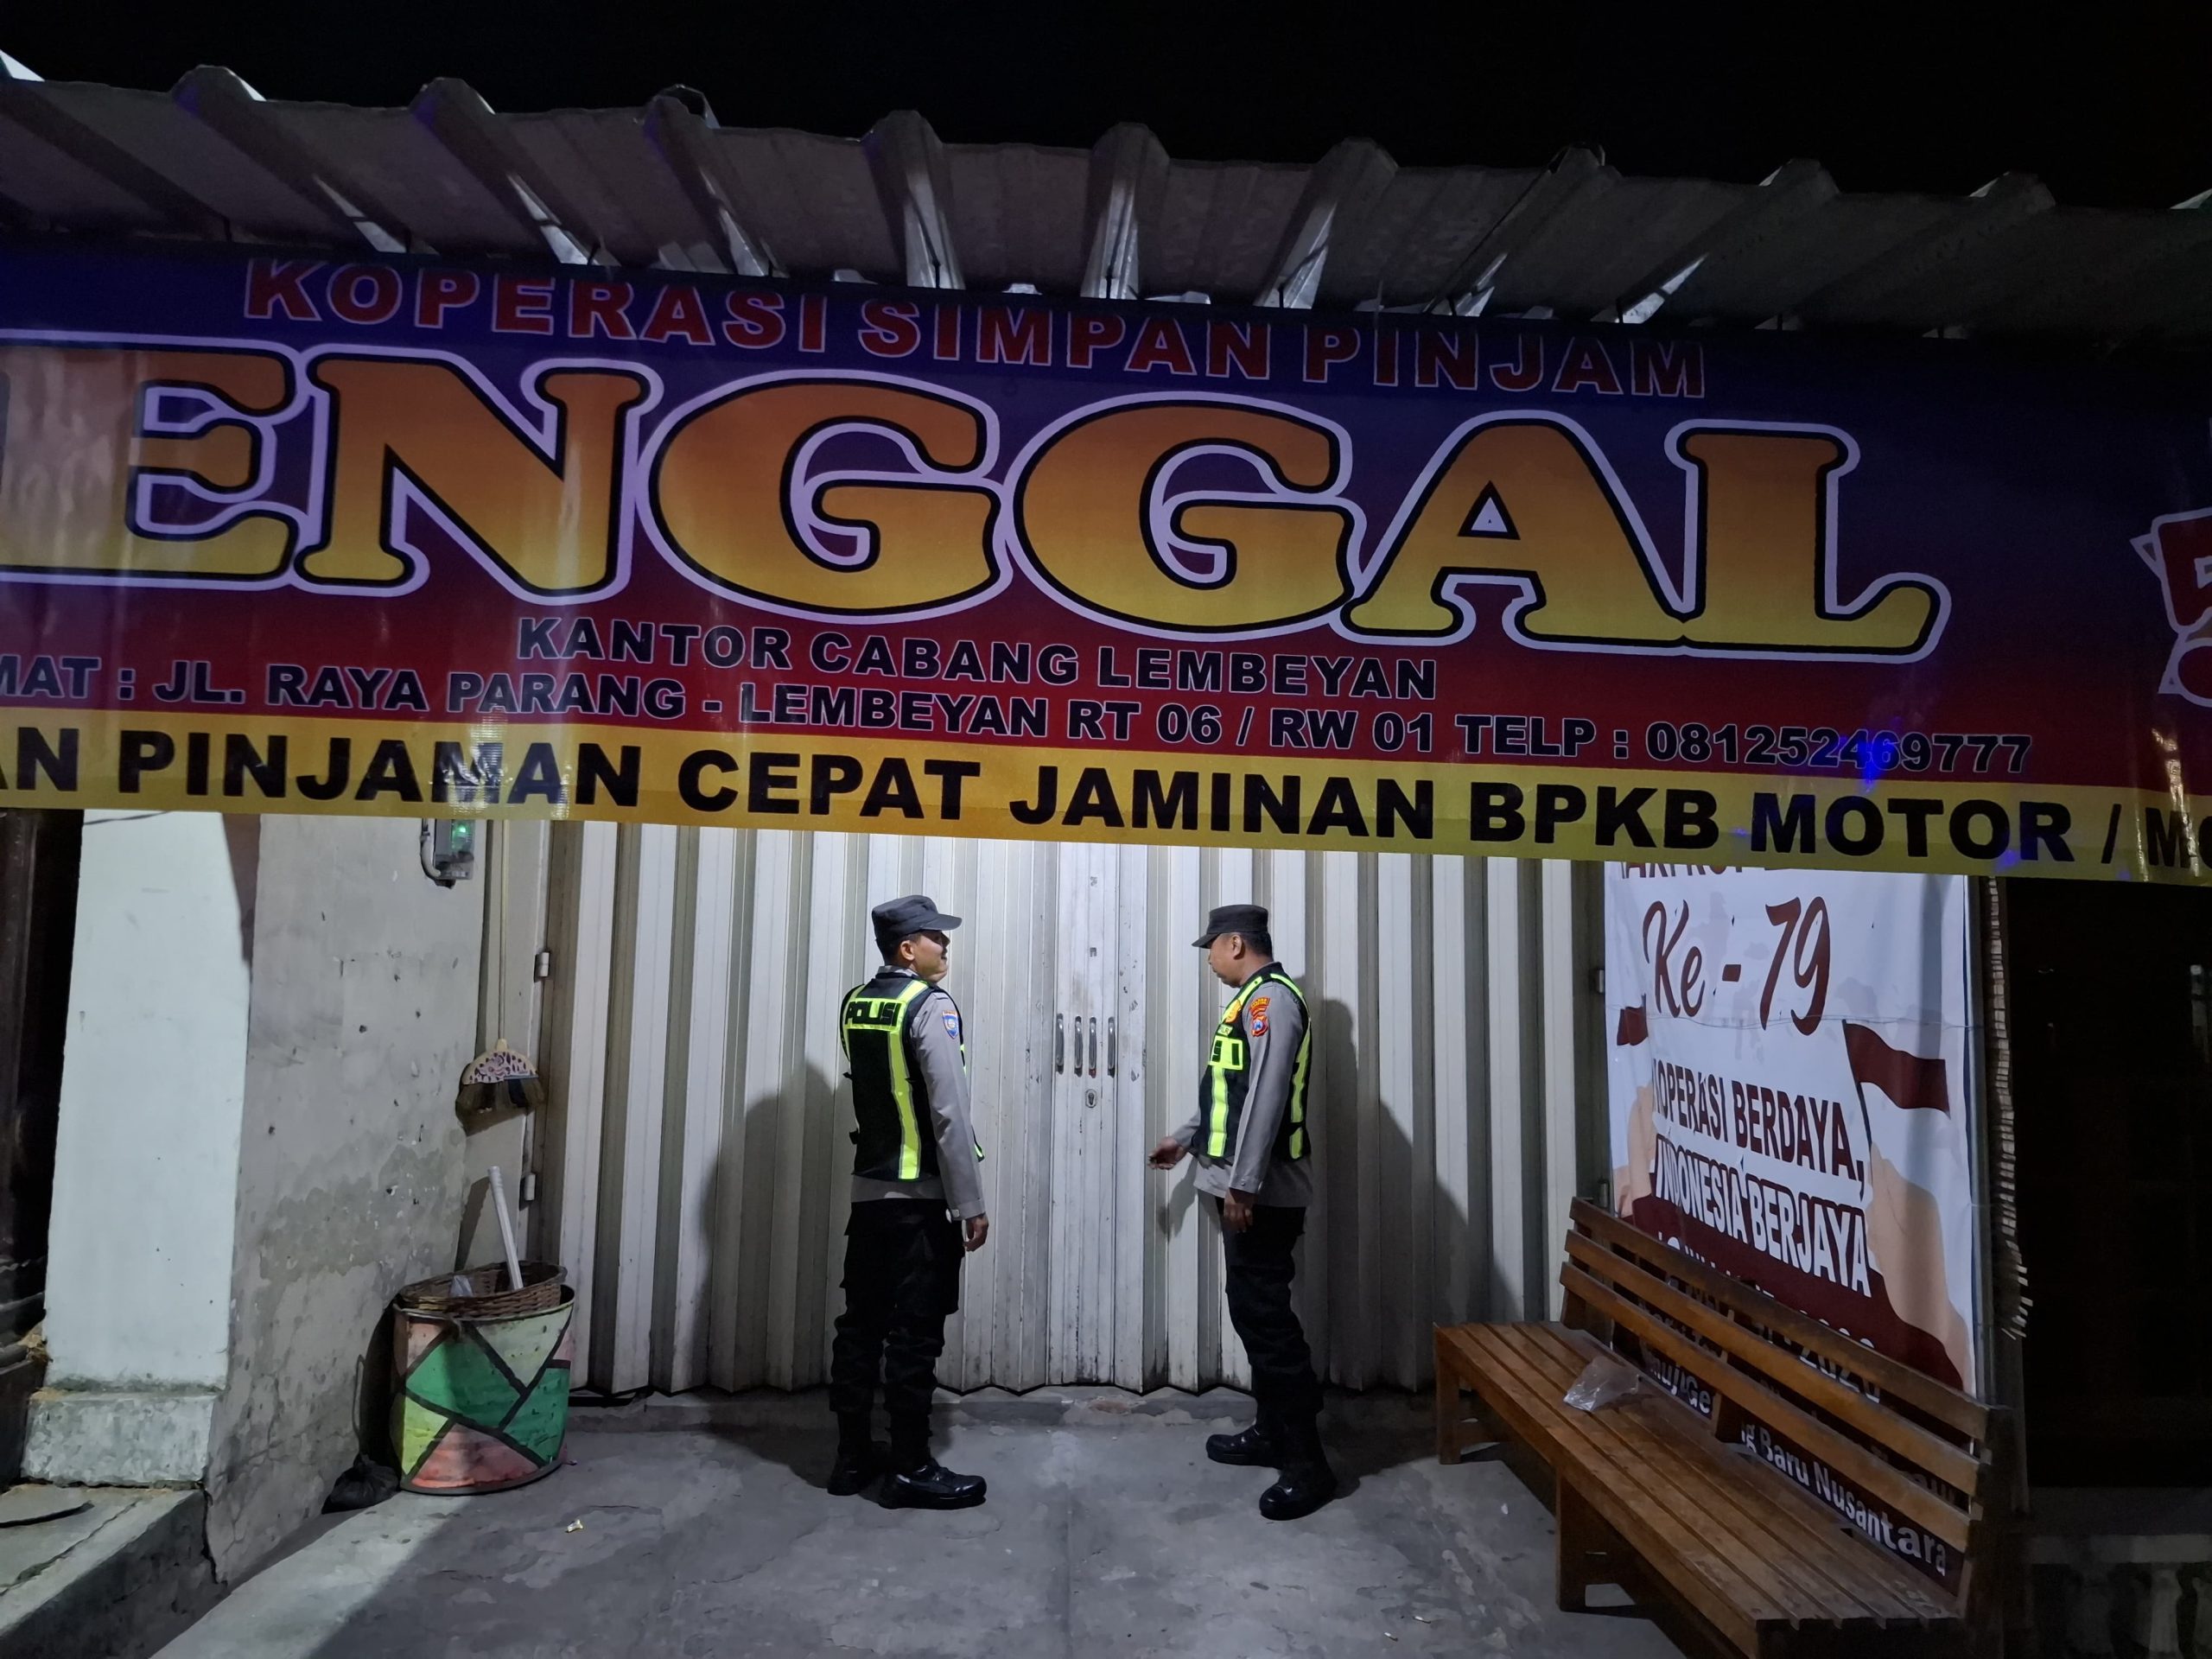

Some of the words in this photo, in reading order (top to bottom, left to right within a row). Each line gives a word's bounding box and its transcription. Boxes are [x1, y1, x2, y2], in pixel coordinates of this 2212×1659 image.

[246, 260, 824, 351] KOPERASI
[860, 302, 1270, 378] SIMPAN
[1304, 326, 1704, 397] PINJAM
[152, 660, 245, 704] JL.
[265, 664, 428, 713] RAYA
[448, 671, 688, 720] PARANG
[740, 683, 1047, 740] LEMBEYAN
[1067, 701, 1141, 743] RT
[1155, 703, 1223, 746] 06
[1268, 709, 1358, 753] RW
[1372, 711, 1434, 753] 01
[1456, 715, 1597, 760] TELP
[1645, 721, 2032, 774] 081252469777
[518, 618, 791, 670] KANTOR
[810, 632, 1079, 686] CABANG
[1097, 645, 1436, 701] LEMBEYAN
[0, 727, 79, 792] N
[118, 730, 639, 808] PINJAMAN
[677, 750, 981, 820] CEPAT
[1009, 765, 1434, 842] JAMINAN
[1469, 781, 1719, 850] BPKB
[1751, 792, 2075, 864] MOTOR
[2145, 806, 2212, 871] M
[845, 1001, 902, 1027] POLISI
[1642, 899, 1706, 1018] Ke
[1759, 896, 1832, 1036] 79
[1732, 1080, 1865, 1203] BERDAYA,
[1747, 1179, 1872, 1298] BERJAYA
[1813, 1460, 1946, 1578] Nusantara
